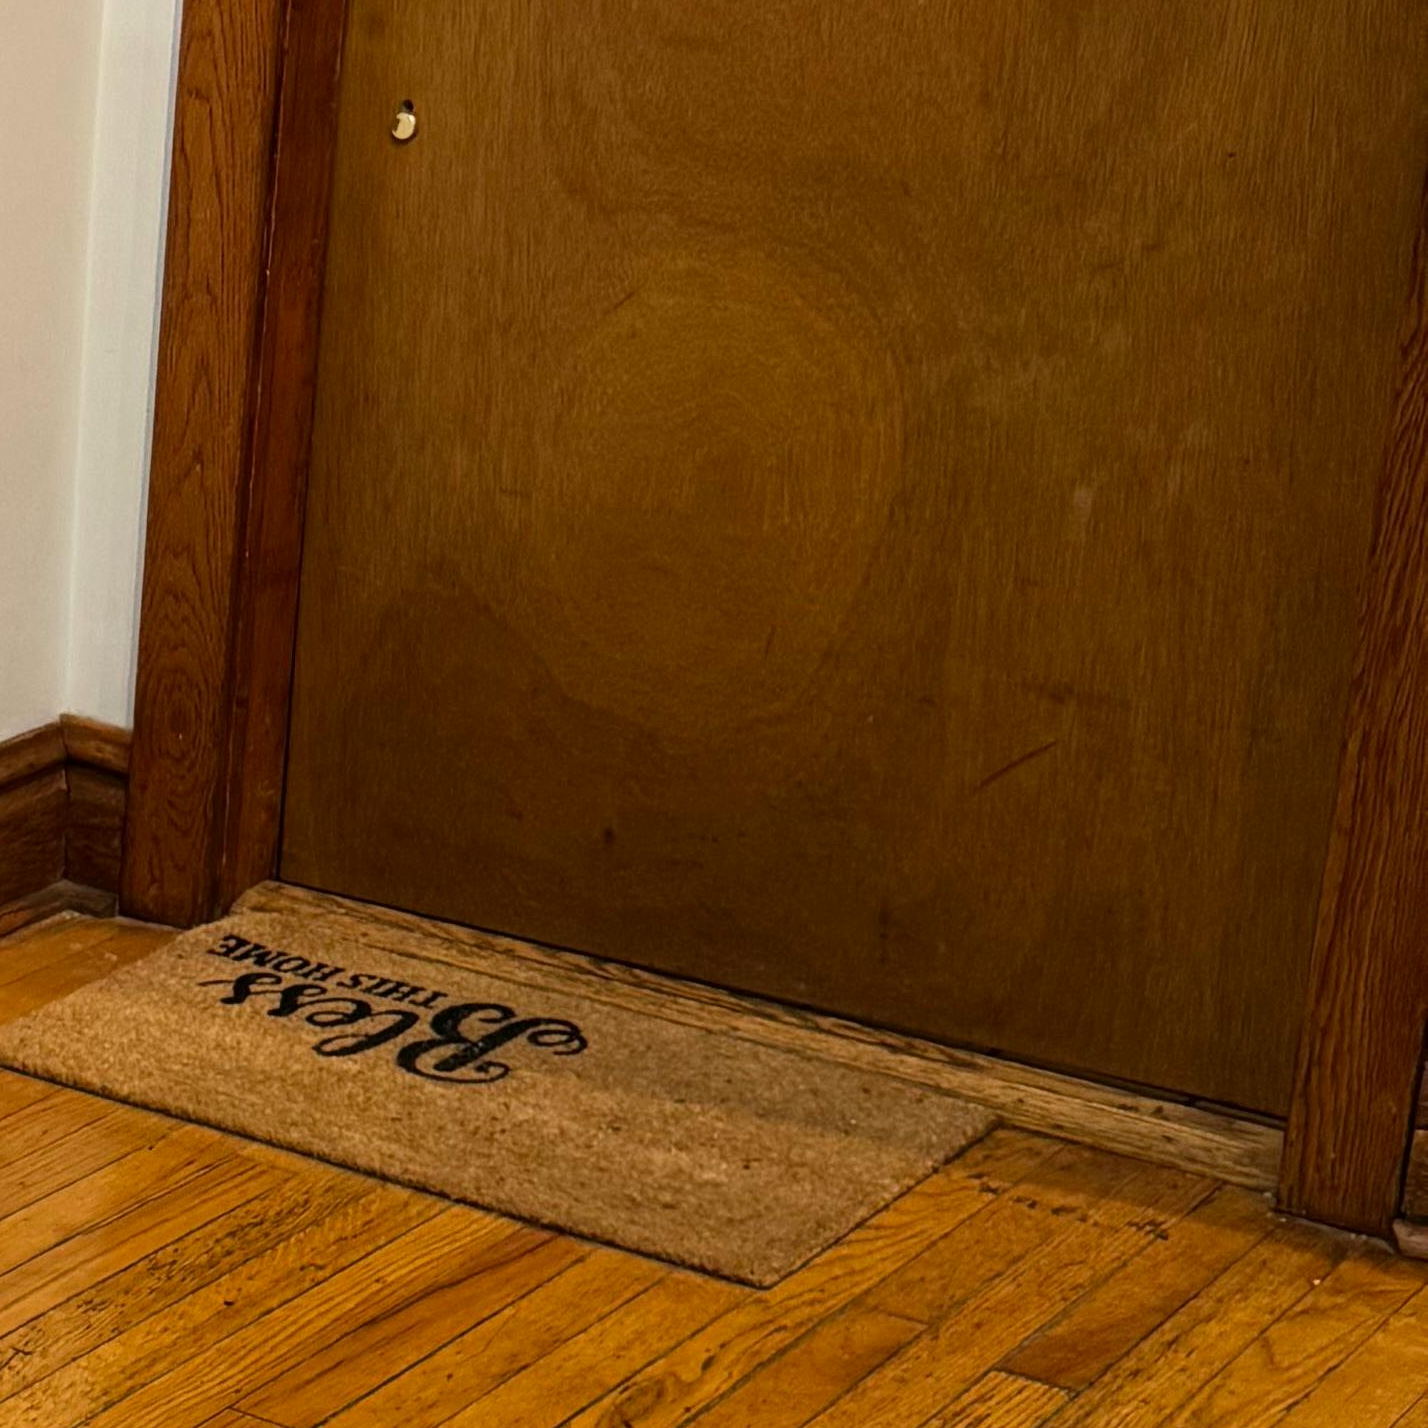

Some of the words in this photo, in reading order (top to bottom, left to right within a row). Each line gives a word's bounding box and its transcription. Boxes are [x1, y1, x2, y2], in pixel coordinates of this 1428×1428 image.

[206, 933, 346, 984] HOME
[338, 973, 448, 1009] THIS
[198, 972, 588, 1084] Bless
